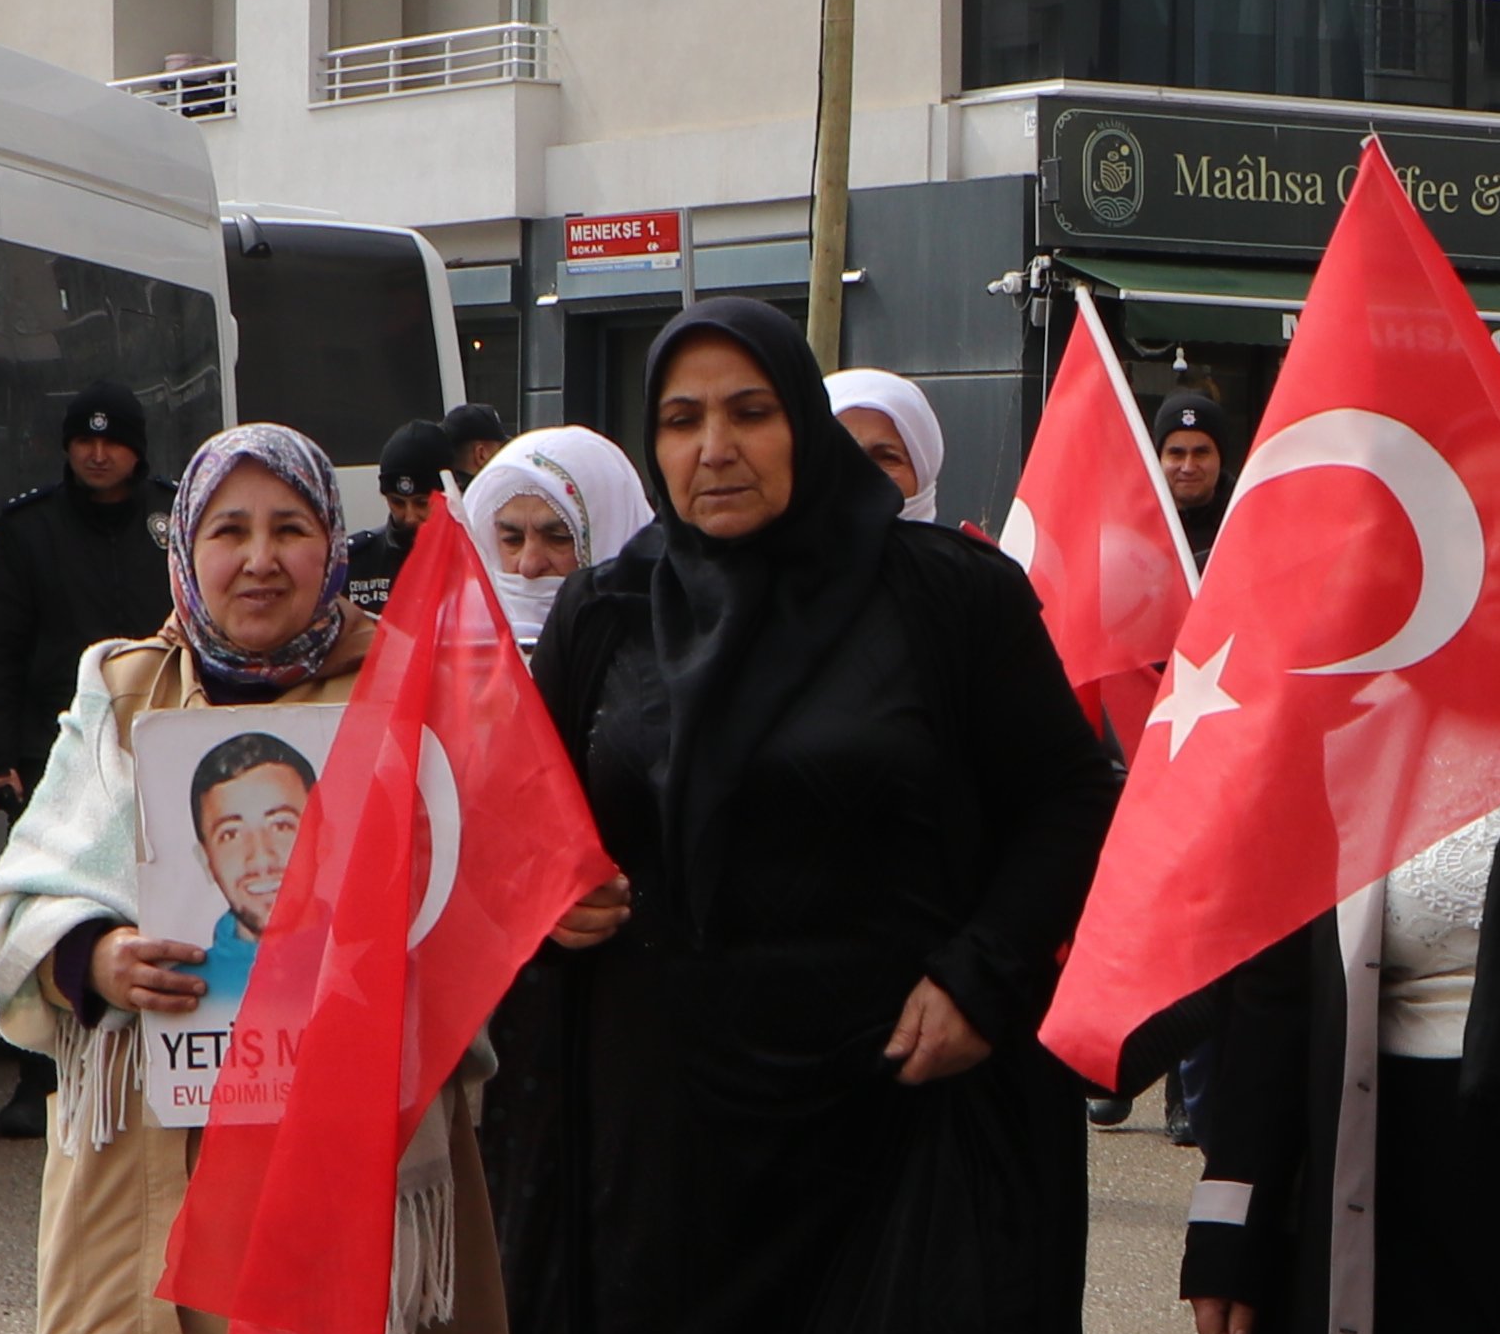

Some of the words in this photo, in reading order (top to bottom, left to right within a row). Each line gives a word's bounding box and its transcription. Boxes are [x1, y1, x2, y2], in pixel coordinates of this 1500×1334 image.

[1175, 153, 1326, 205] Maâhsa
[1336, 164, 1459, 213] Cfee
[570, 221, 642, 242] MENEKŞE
[647, 220, 660, 236] 1.
[572, 245, 604, 255] SOKAK
[160, 1021, 265, 1079] YETİŞ
[173, 1084, 267, 1106] EVLADIMI
